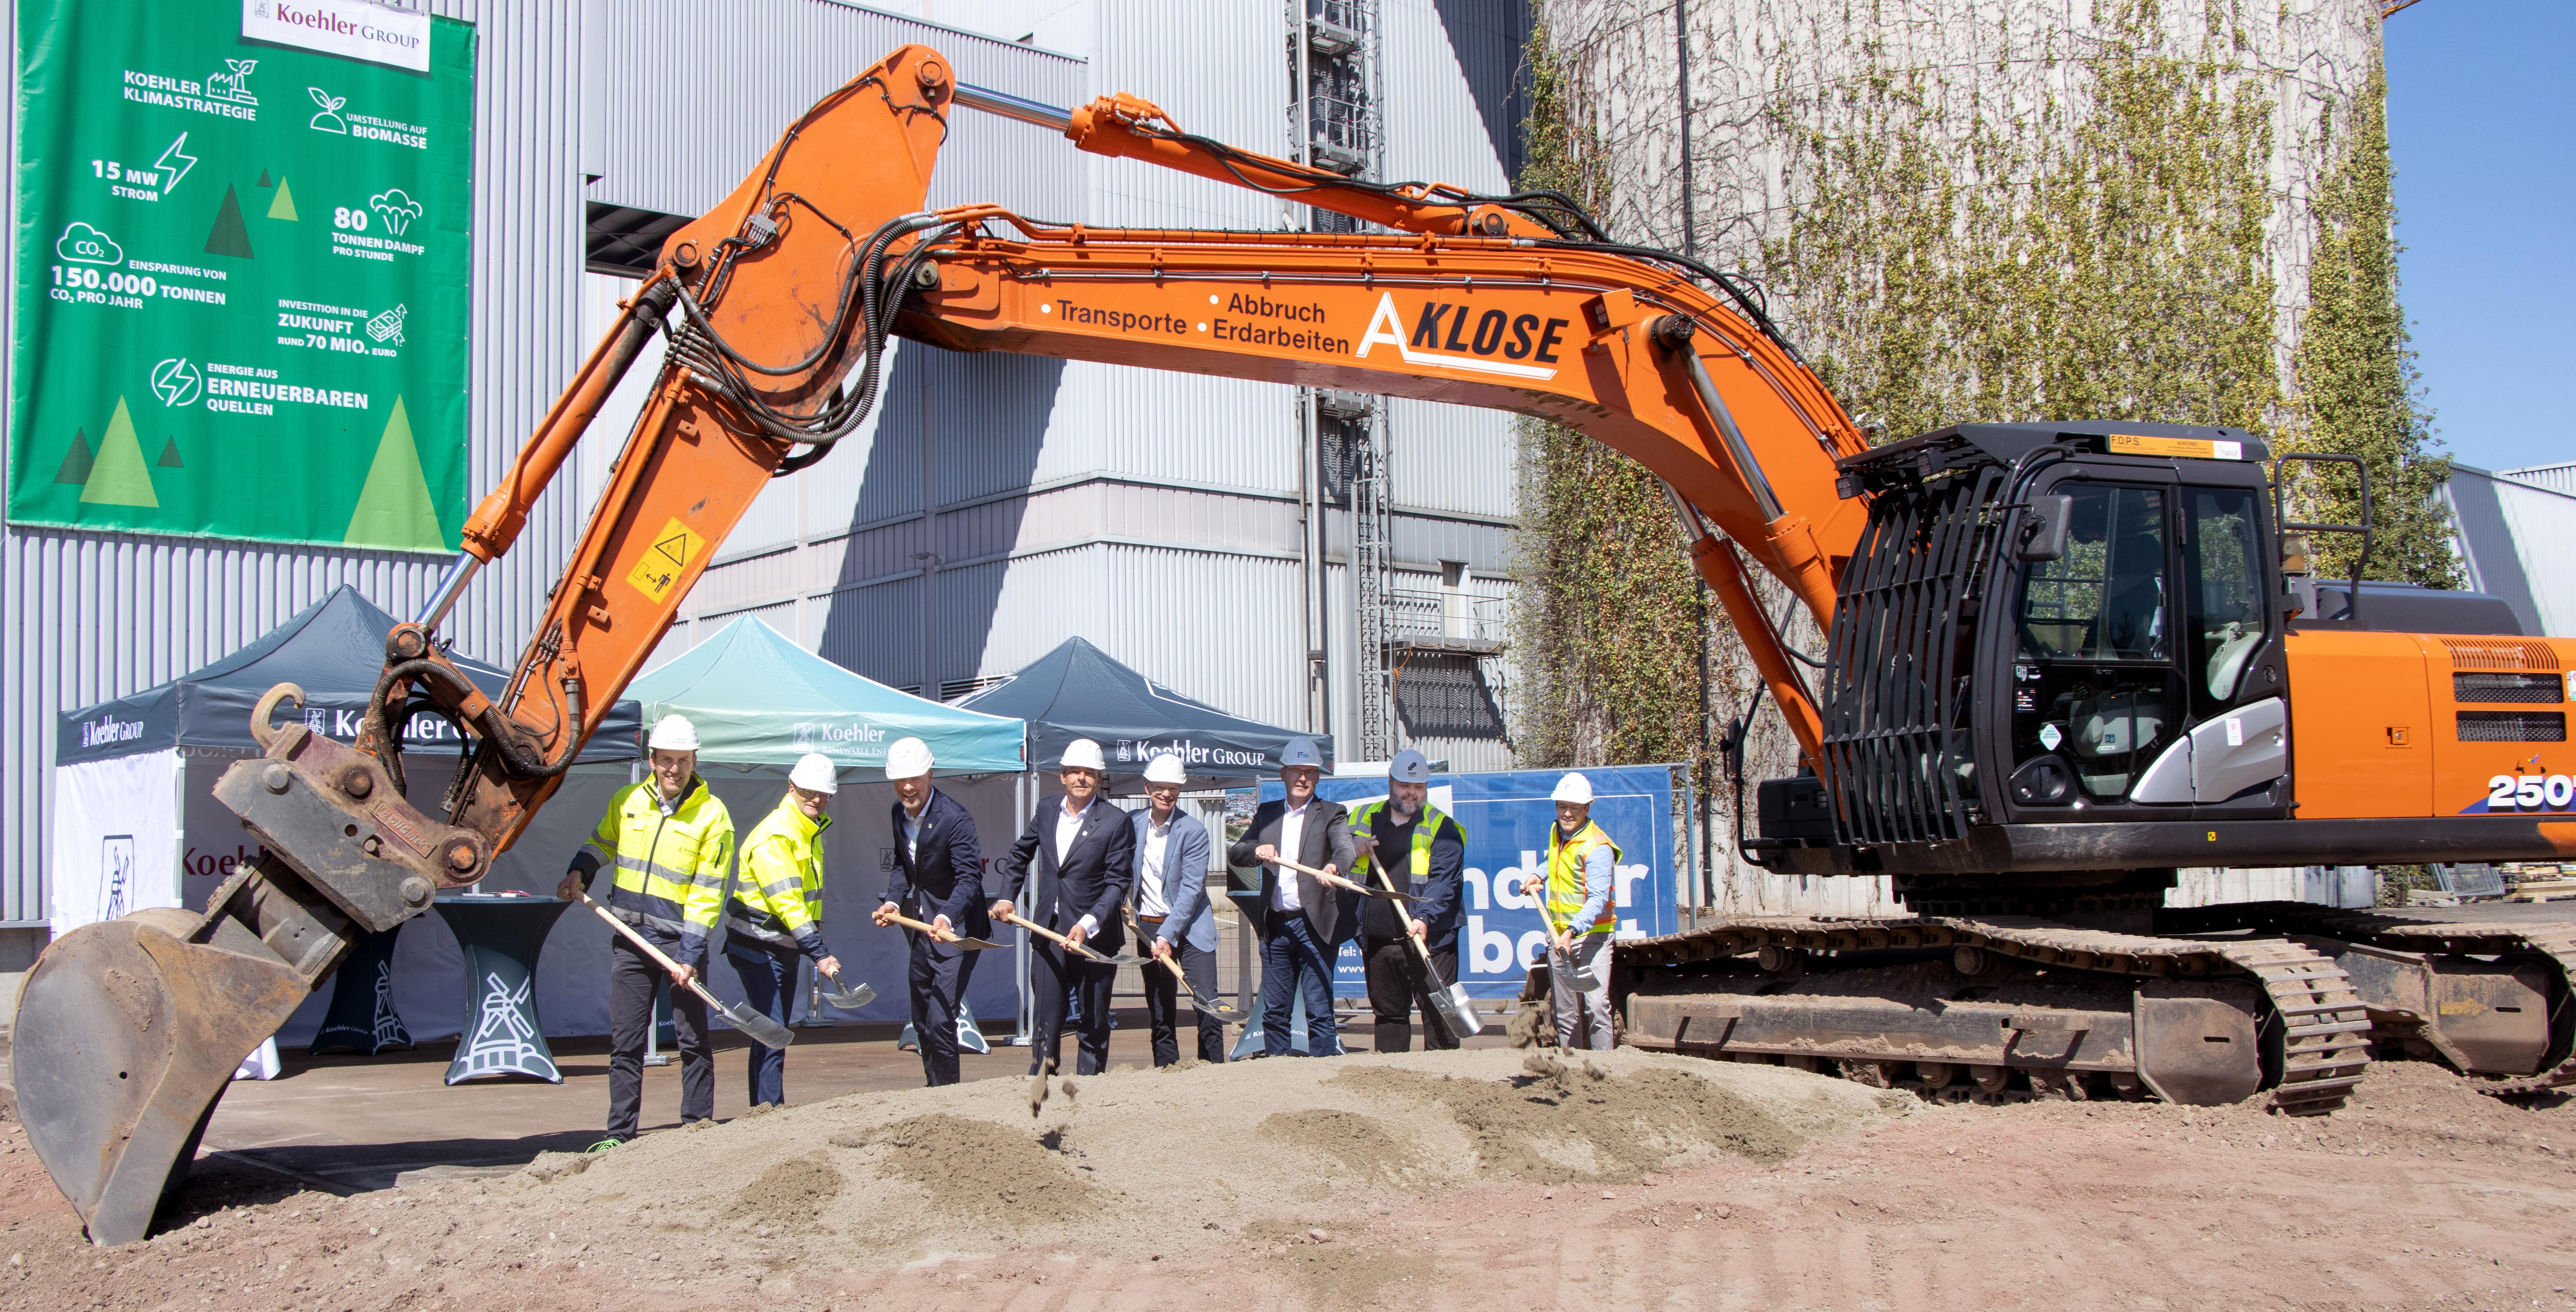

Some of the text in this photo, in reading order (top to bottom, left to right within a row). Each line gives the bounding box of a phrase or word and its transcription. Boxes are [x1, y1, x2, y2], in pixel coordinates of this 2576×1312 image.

[277, 3, 419, 48] Koehler GROUP
[124, 70, 201, 96] KOEHLER
[123, 86, 256, 121] KLIMASTRATEGIE
[346, 112, 428, 135] UMSTELLUNG AUF
[352, 124, 427, 149] BIOMASSE
[92, 160, 159, 186] 15 MW
[112, 185, 158, 202] STROM
[334, 207, 367, 231] 80
[332, 231, 424, 255] TONNEN DAMPF
[333, 245, 394, 262] PRO STUNDE
[129, 259, 226, 280] EINSPARUNG VON
[51, 265, 226, 305] 150.000 TONNEN
[77, 290, 106, 304] PRO
[108, 294, 143, 309] JAHR
[278, 299, 368, 318] INVESTITION IN DIE
[1228, 293, 1325, 324] Abbruch
[278, 313, 354, 334] ZUKUNFT
[1057, 299, 1350, 354] Transporte Erdarbeiten
[1410, 301, 1570, 364] KLOSE
[277, 334, 397, 357] RUND 70 MIO. EURO
[207, 362, 278, 379] ENERGIE AUS
[207, 377, 368, 409] ERNEUERBAREN
[206, 398, 273, 416] QUELLEN
[2111, 435, 2141, 445] F.O.P.S.
[90, 715, 144, 746] Koehler GROUP
[822, 723, 885, 742] Koehler
[823, 745, 869, 755] RENEWABLE
[1213, 748, 1265, 766] GROUP
[1338, 946, 1356, 956] Tel:
[325, 1024, 350, 1033] Koehler
